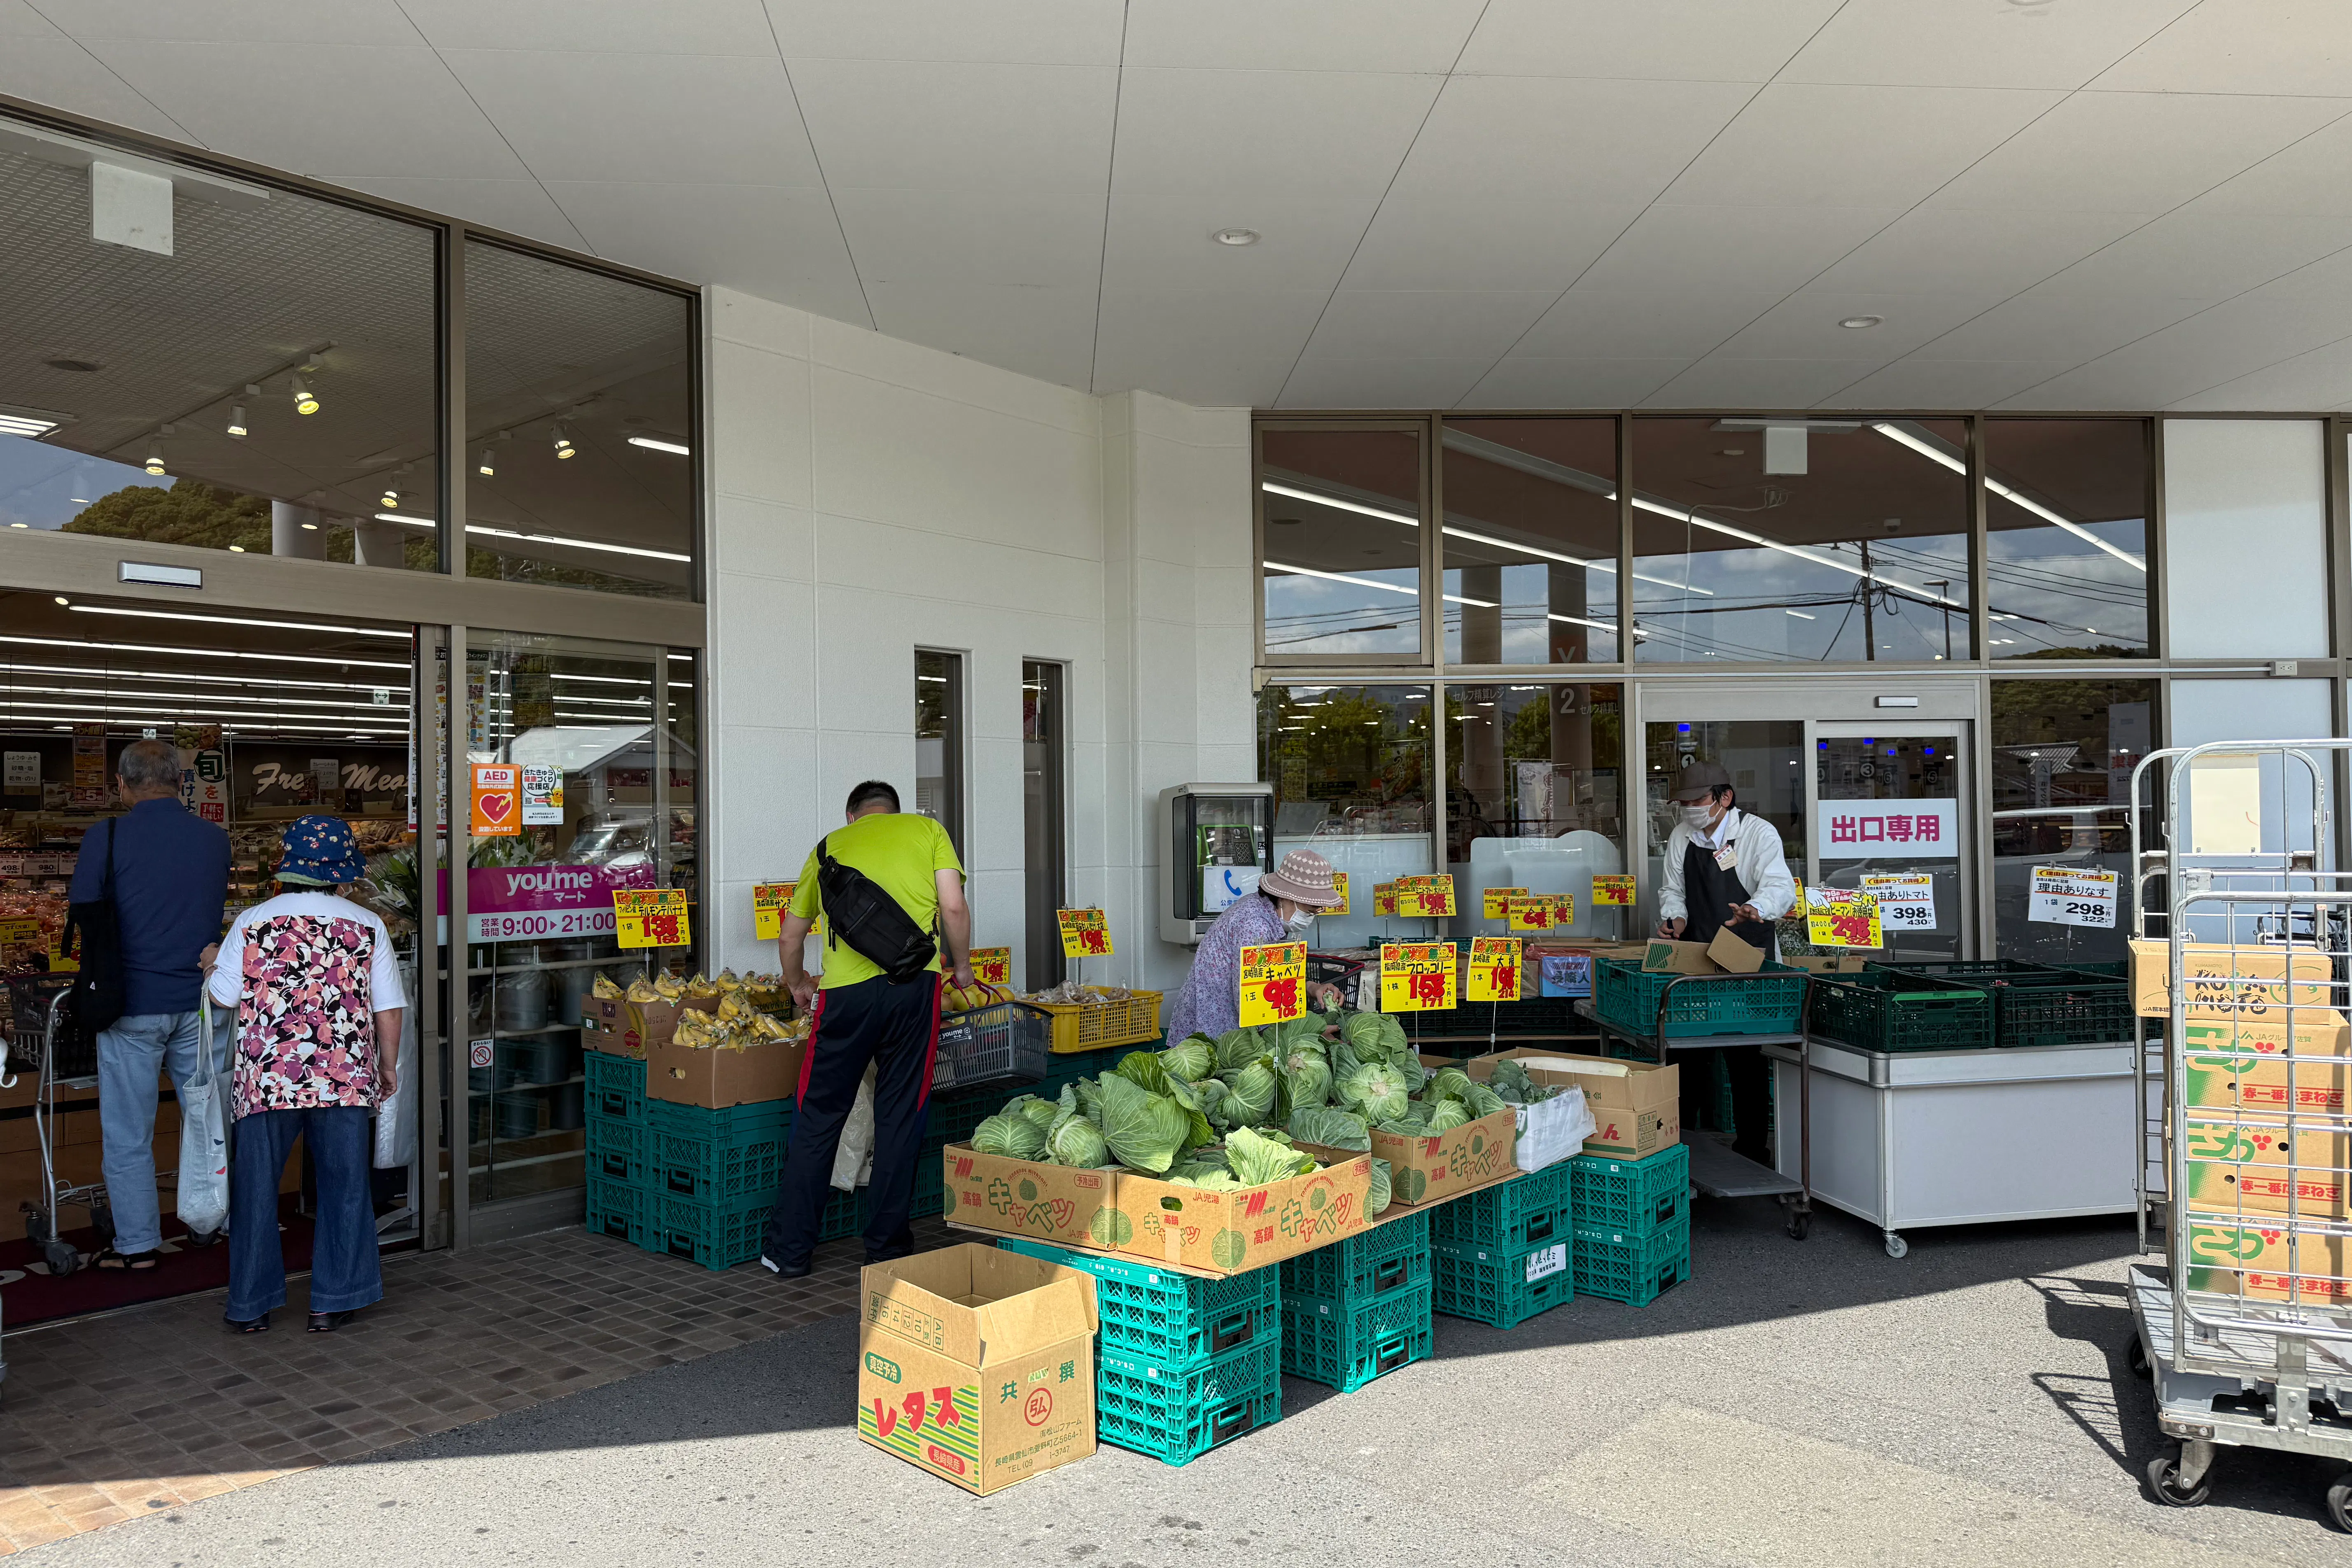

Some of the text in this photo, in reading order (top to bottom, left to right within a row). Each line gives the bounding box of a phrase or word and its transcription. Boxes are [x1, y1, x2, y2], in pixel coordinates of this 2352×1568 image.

[1560, 688, 1575, 714] 2
[341, 763, 409, 792] Mea
[484, 771, 508, 780] AED
[1831, 814, 1940, 842] 出口専用
[506, 871, 593, 896] youme
[2038, 883, 2109, 897] 理由ありなす
[553, 891, 586, 903] マート
[1418, 893, 1447, 910] 198
[1878, 891, 1928, 900] 由ありトマト
[1893, 907, 1927, 919] 398
[2065, 902, 2105, 916] 298
[481, 918, 499, 927] 営業
[502, 912, 617, 936] 9:00 21:00
[641, 915, 679, 938] 138
[1831, 915, 1871, 938] 298
[481, 928, 499, 937] 時間
[1266, 964, 1301, 981] キャベツ
[1384, 962, 1452, 975] 福岡県産 ブロッコリー
[1491, 967, 1515, 990] 198
[1408, 973, 1446, 999] 158
[1245, 992, 1256, 1002] 1玉
[1263, 978, 1297, 1009] 98
[1498, 989, 1514, 999] 214
[1421, 997, 1443, 1008] 171
[1277, 1005, 1297, 1019] 106
[942, 1029, 963, 1039] youme
[2256, 1033, 2312, 1043] JAグルー佐賀
[2253, 1127, 2309, 1137] JAグルー賀
[1379, 1134, 1404, 1146] JA児湯
[1451, 1140, 1503, 1182] キャベツ
[1431, 1166, 1446, 1182] 高鍋
[963, 1191, 982, 1208] 高鍋
[1192, 1191, 1220, 1204] JA児湯
[988, 1177, 1075, 1233] キャベツ
[1164, 1214, 1179, 1226] 高鍋
[1281, 1192, 1353, 1243] キャベツ
[1253, 1225, 1274, 1246] 高鍋
[882, 1305, 889, 1318] 16
[893, 1309, 900, 1323] 14
[903, 1314, 911, 1328] 12
[915, 1319, 922, 1332] 10
[936, 1322, 941, 1331] A
[935, 1336, 941, 1345] B
[870, 1355, 897, 1381] 真空予冷
[1059, 1359, 1075, 1384] 撰
[1000, 1380, 1017, 1404] 共
[873, 1386, 961, 1437] レタス
[1030, 1396, 1048, 1418] 弘
[933, 1449, 960, 1472] 長崎県産
[1008, 1464, 1021, 1474] TEL
